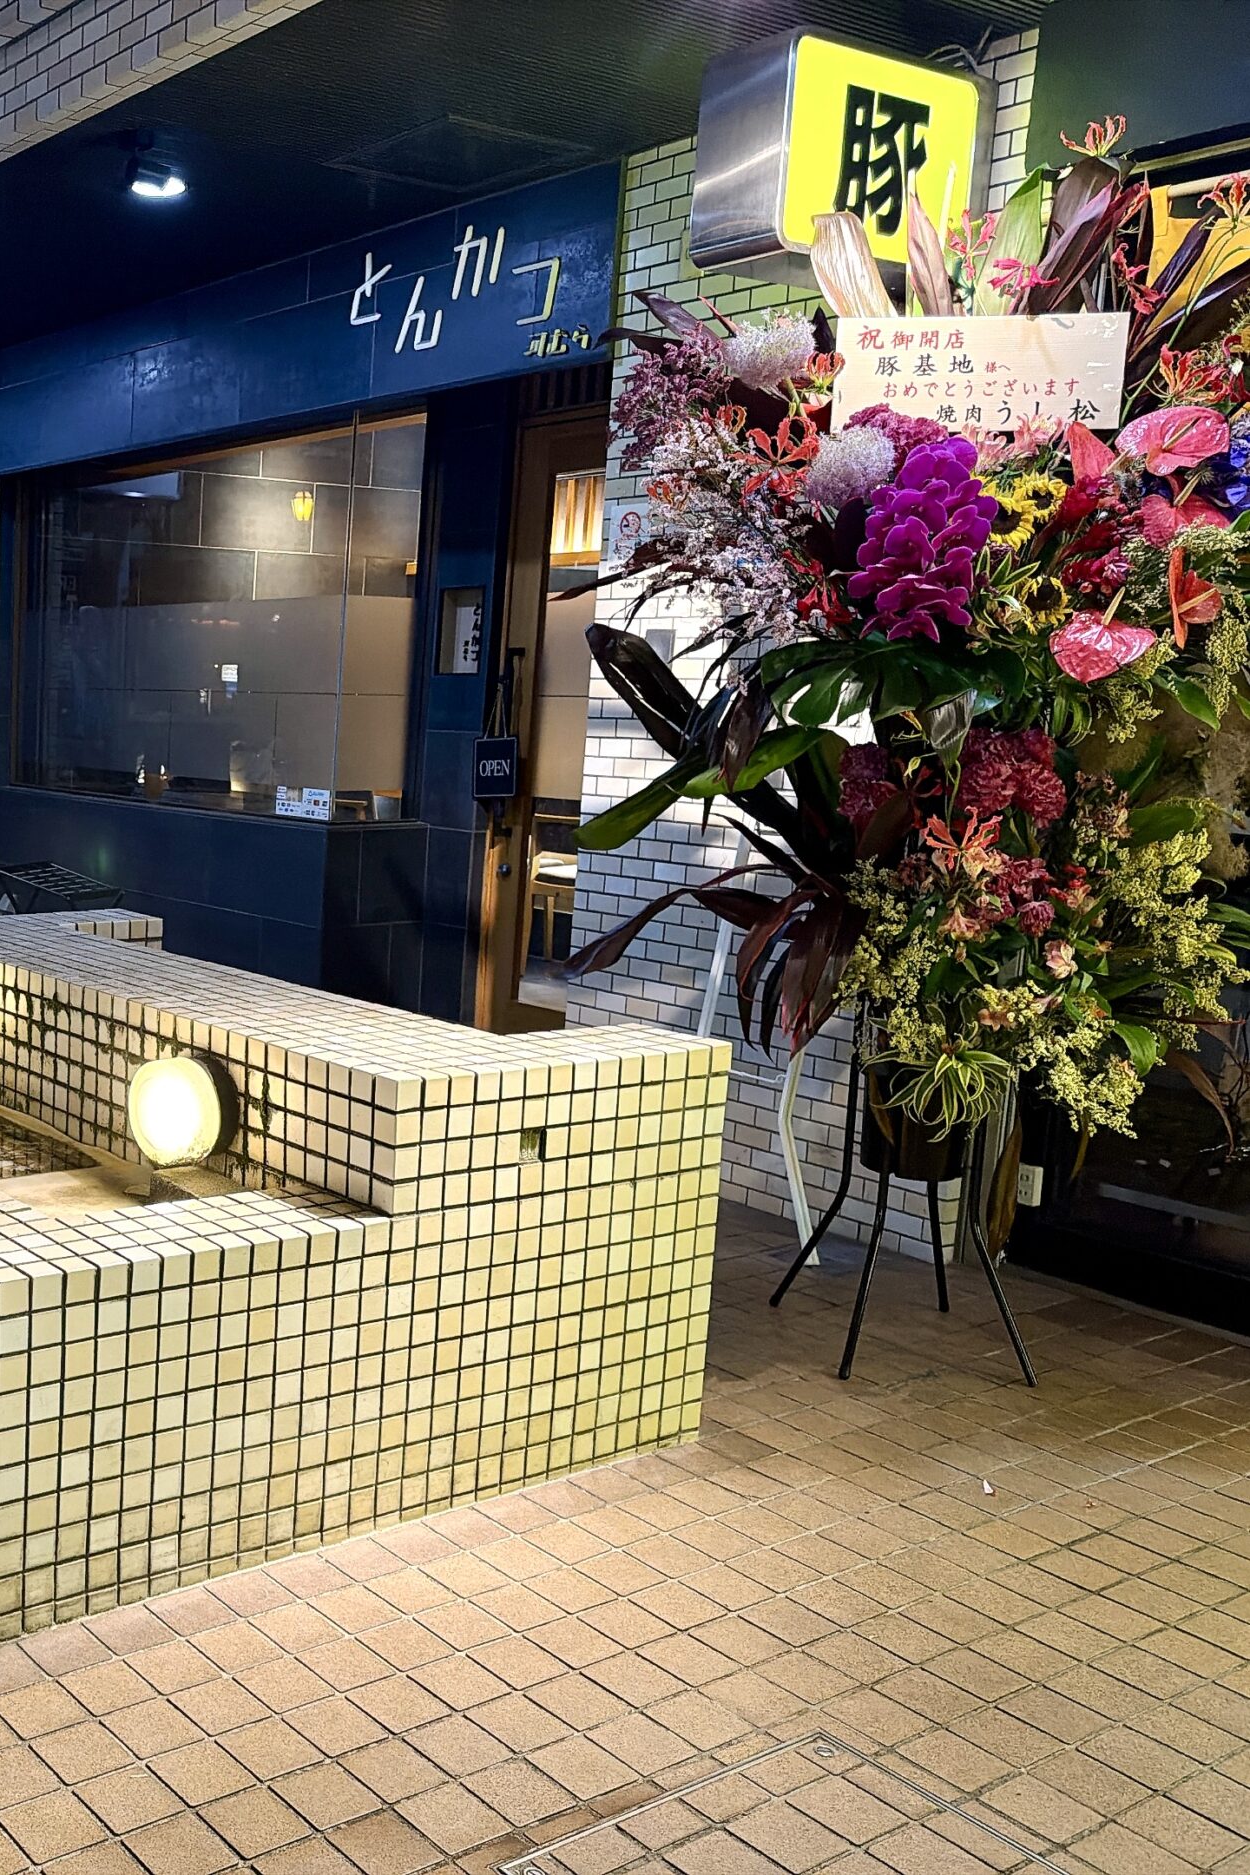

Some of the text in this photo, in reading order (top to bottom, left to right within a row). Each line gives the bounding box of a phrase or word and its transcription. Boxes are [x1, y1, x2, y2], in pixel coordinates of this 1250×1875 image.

[833, 83, 930, 236] 豚
[349, 224, 561, 355] とんかつ
[856, 324, 966, 351] 祝御開店
[882, 376, 1082, 399] おめでとうございます
[479, 759, 511, 777] OPEN
